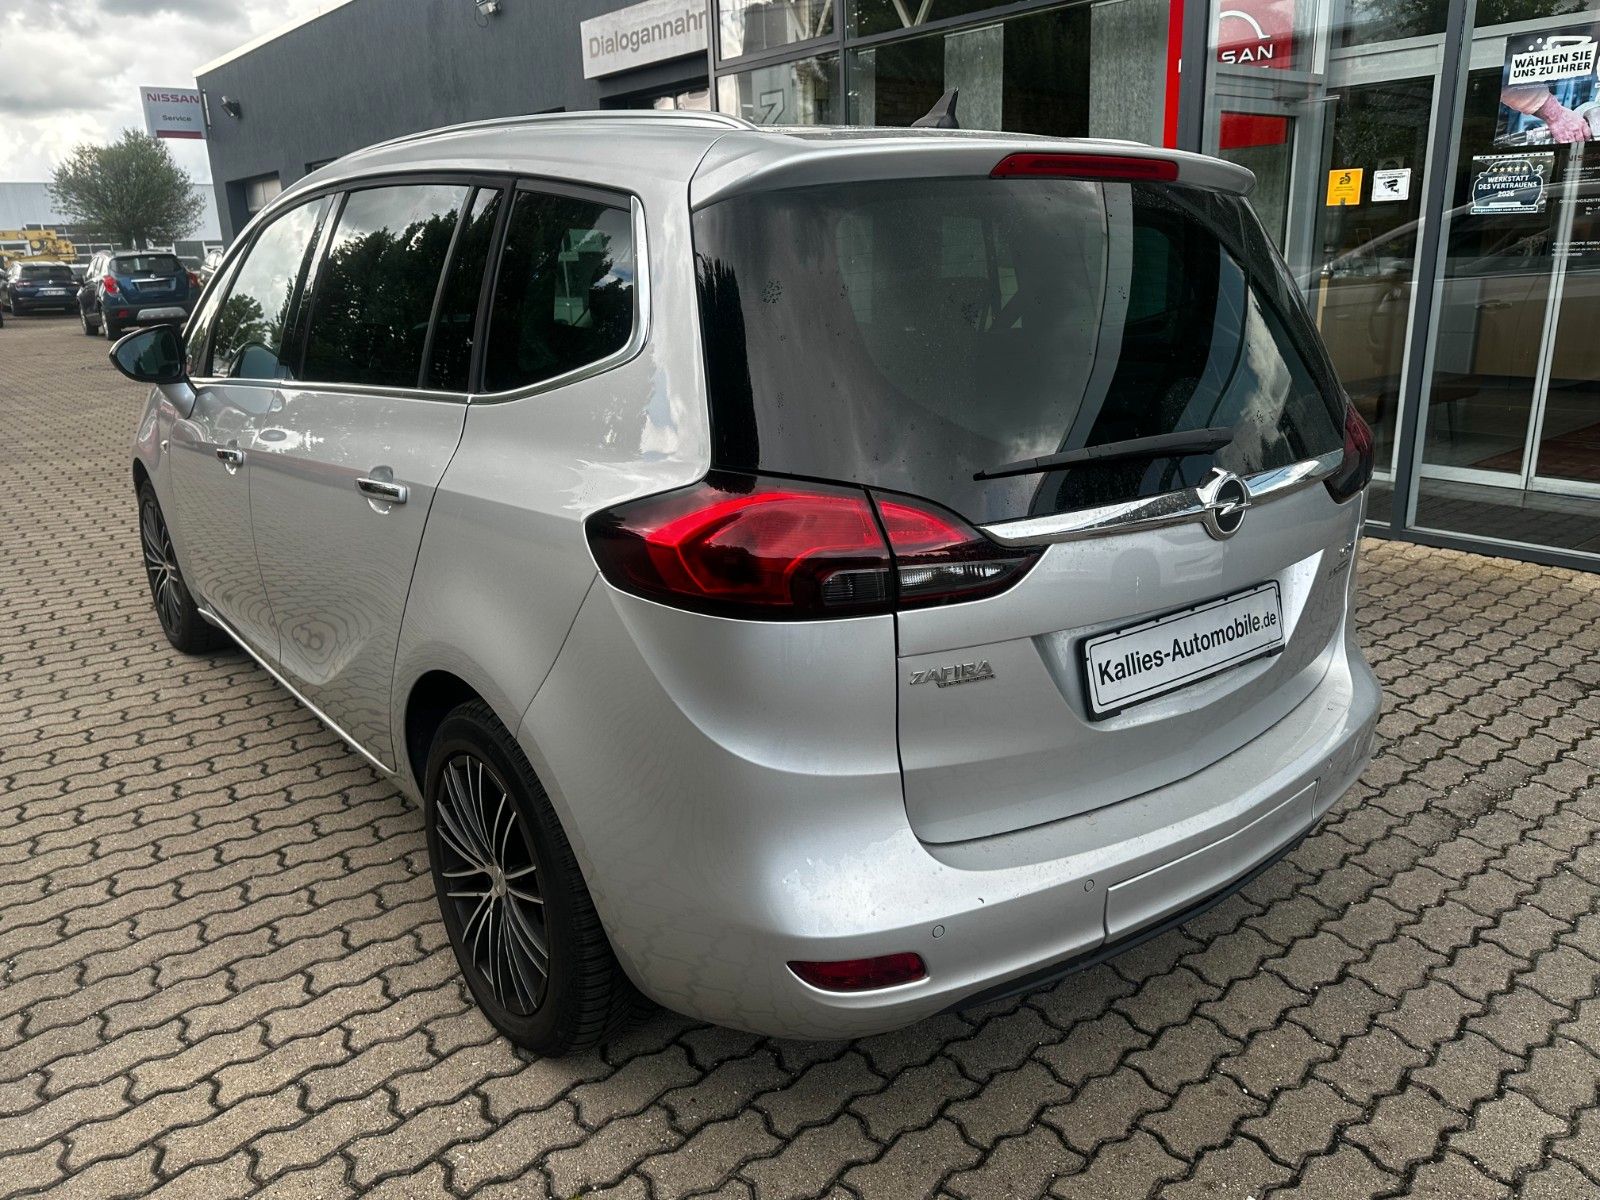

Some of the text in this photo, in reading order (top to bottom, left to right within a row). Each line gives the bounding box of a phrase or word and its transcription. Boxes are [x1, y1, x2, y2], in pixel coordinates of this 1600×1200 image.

[1514, 50, 1592, 68] WÄHLEN SIE
[1513, 61, 1591, 78] UNS ZU IHRER
[147, 93, 200, 104] NISSAN
[1487, 174, 1530, 183] WERKSTATT
[1492, 181, 1538, 189] VERTRAUENS
[1098, 611, 1277, 686] Kallies-Automobile.de
[909, 660, 994, 685] ZAFIRA
